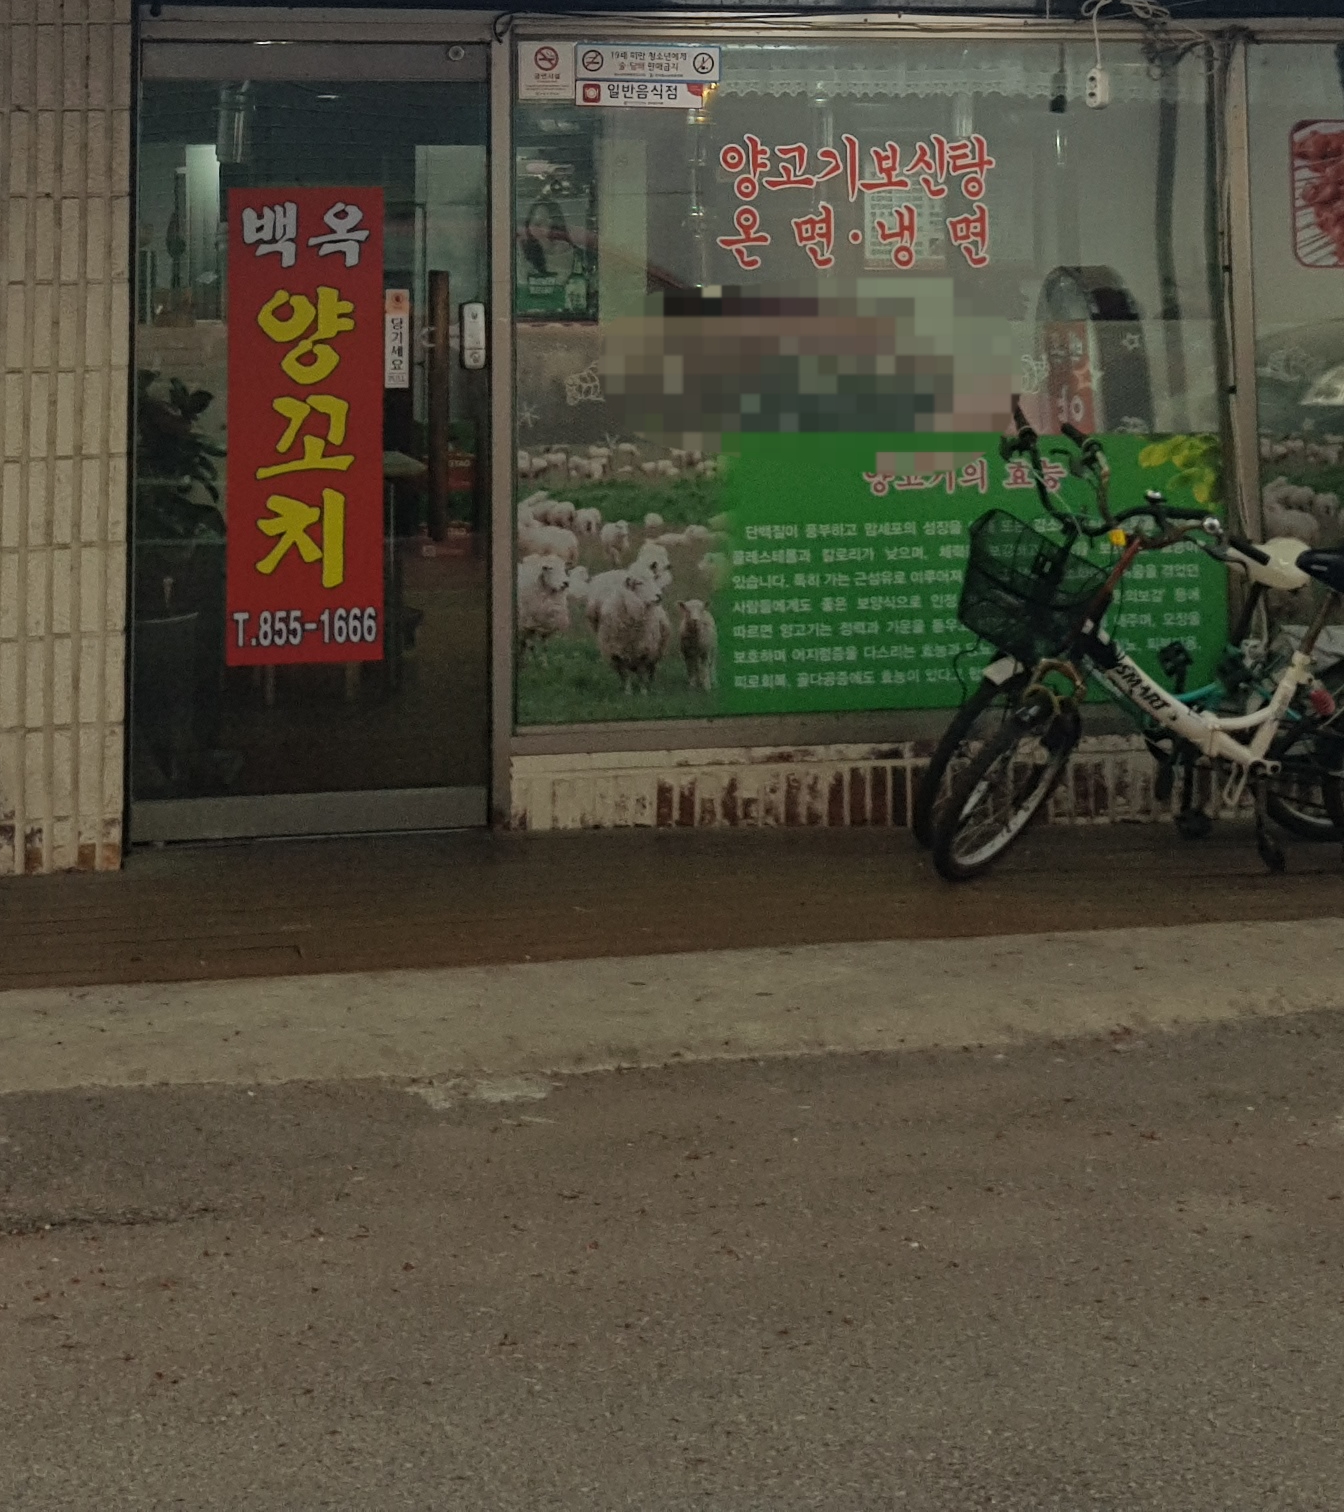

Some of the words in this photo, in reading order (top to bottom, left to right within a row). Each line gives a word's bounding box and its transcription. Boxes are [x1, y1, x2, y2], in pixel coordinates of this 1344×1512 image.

[607, 83, 679, 100] 일반음식점
[719, 133, 995, 201] 양고기보신탕
[391, 316, 404, 371] 당기세요
[255, 285, 357, 589] 양꼬치
[234, 606, 377, 648] T.855-1666
[779, 622, 833, 638] 양고기는
[863, 644, 916, 660] 다스리는
